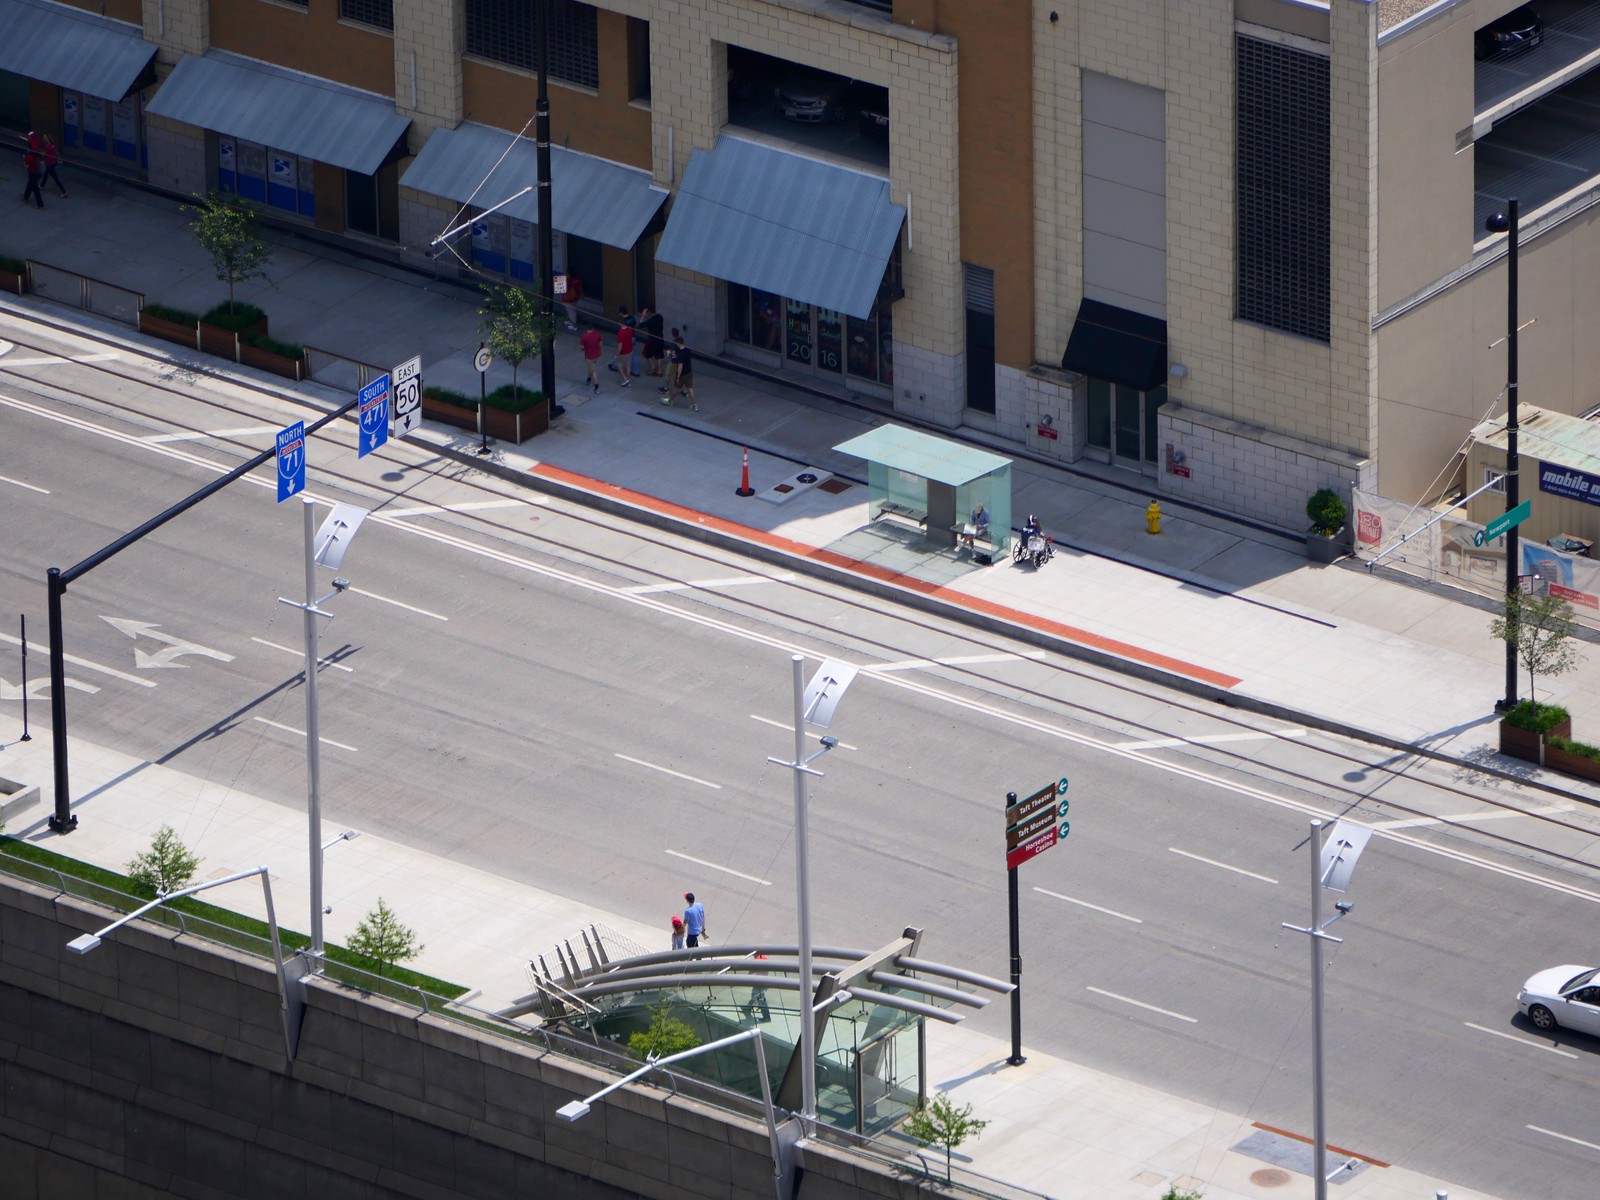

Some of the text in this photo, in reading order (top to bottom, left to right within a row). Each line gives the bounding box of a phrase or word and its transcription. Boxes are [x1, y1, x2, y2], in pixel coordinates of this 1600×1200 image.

[791, 342, 837, 367] 20 16
[398, 363, 415, 380] EAST
[363, 380, 385, 401] SOUTH
[399, 384, 417, 409] 50
[364, 404, 384, 426] 471
[279, 425, 302, 446] NORTH
[284, 451, 298, 472] 71
[1543, 471, 1589, 492] mobile
[1488, 519, 1510, 535] Newport
[1019, 792, 1053, 815] Taft Theater
[1018, 814, 1053, 838] Taft Museum
[1025, 832, 1053, 851] Horseshoe
[1035, 840, 1053, 853] Casino
